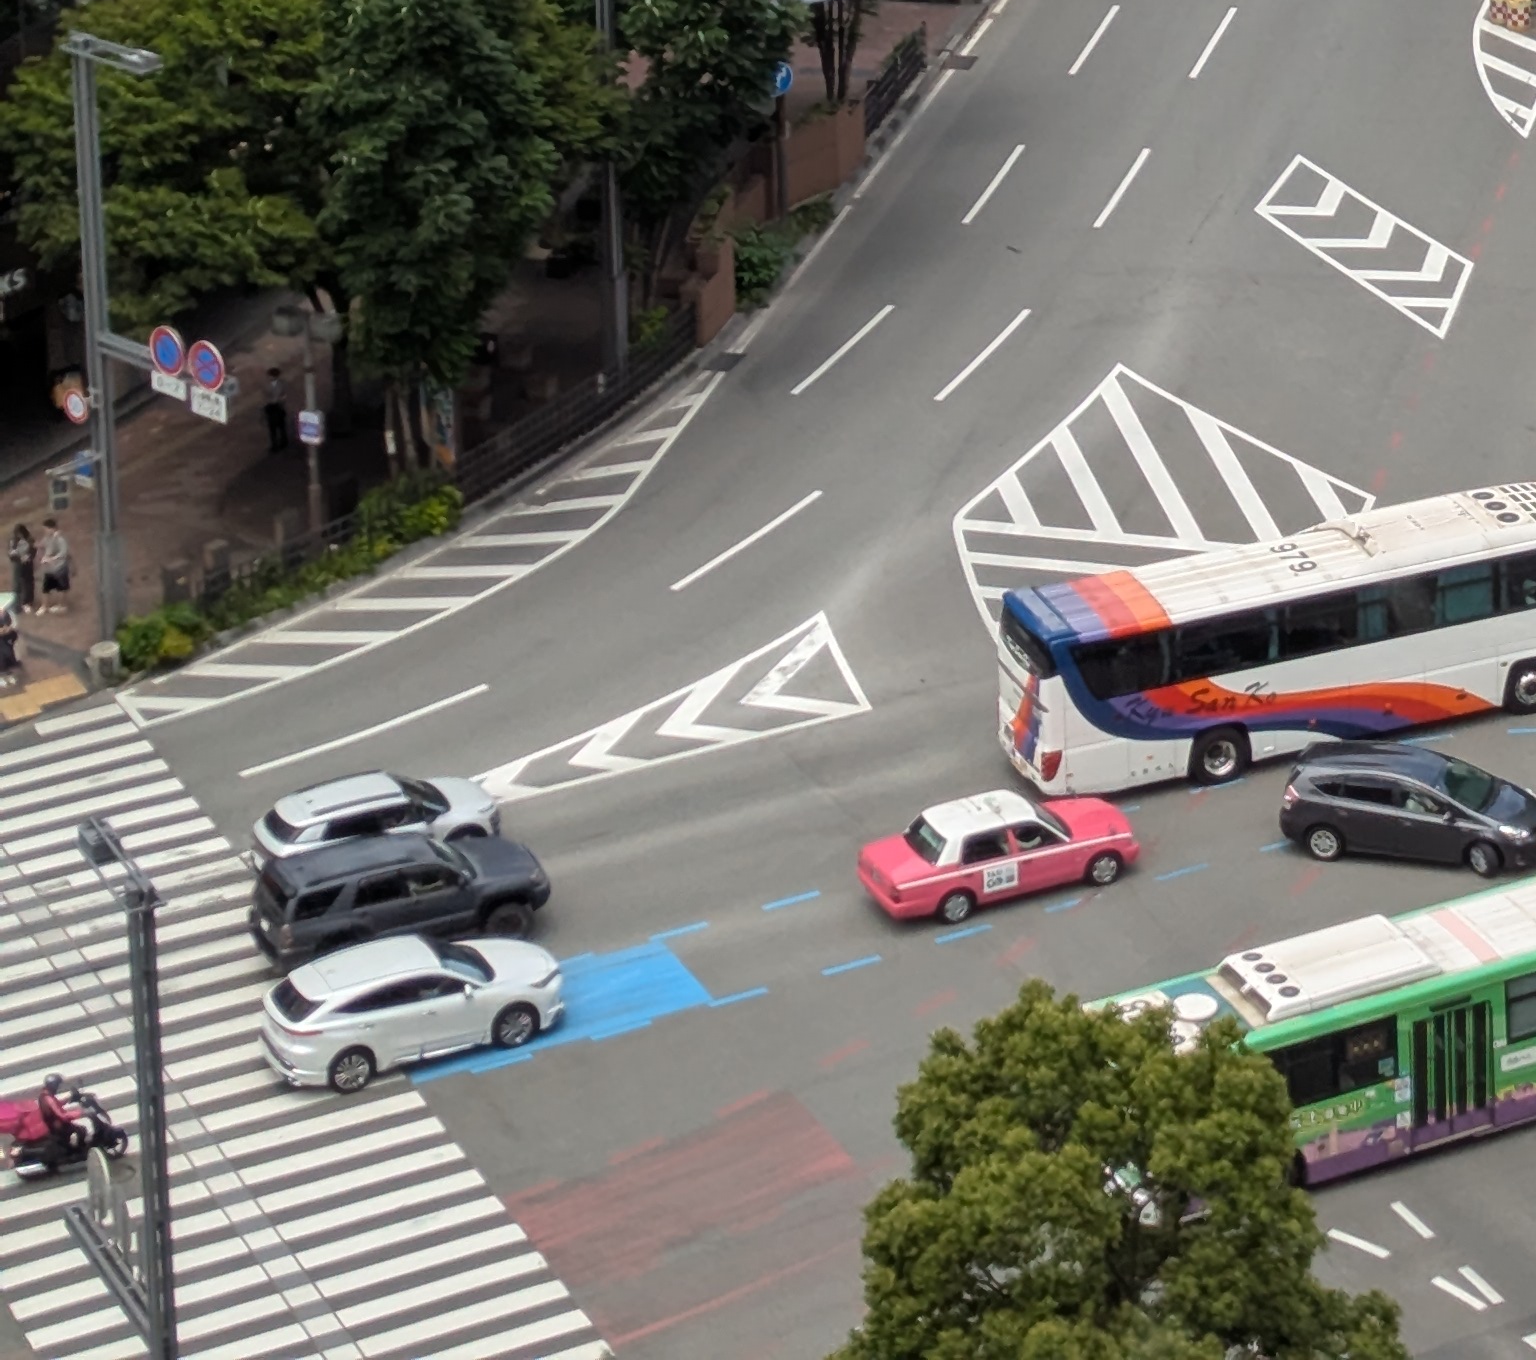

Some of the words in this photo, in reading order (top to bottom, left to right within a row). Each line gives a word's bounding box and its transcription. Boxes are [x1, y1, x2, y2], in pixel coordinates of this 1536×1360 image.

[1270, 542, 1318, 573] 979
[1185, 687, 1236, 715] San
[1244, 680, 1277, 704] Ko
